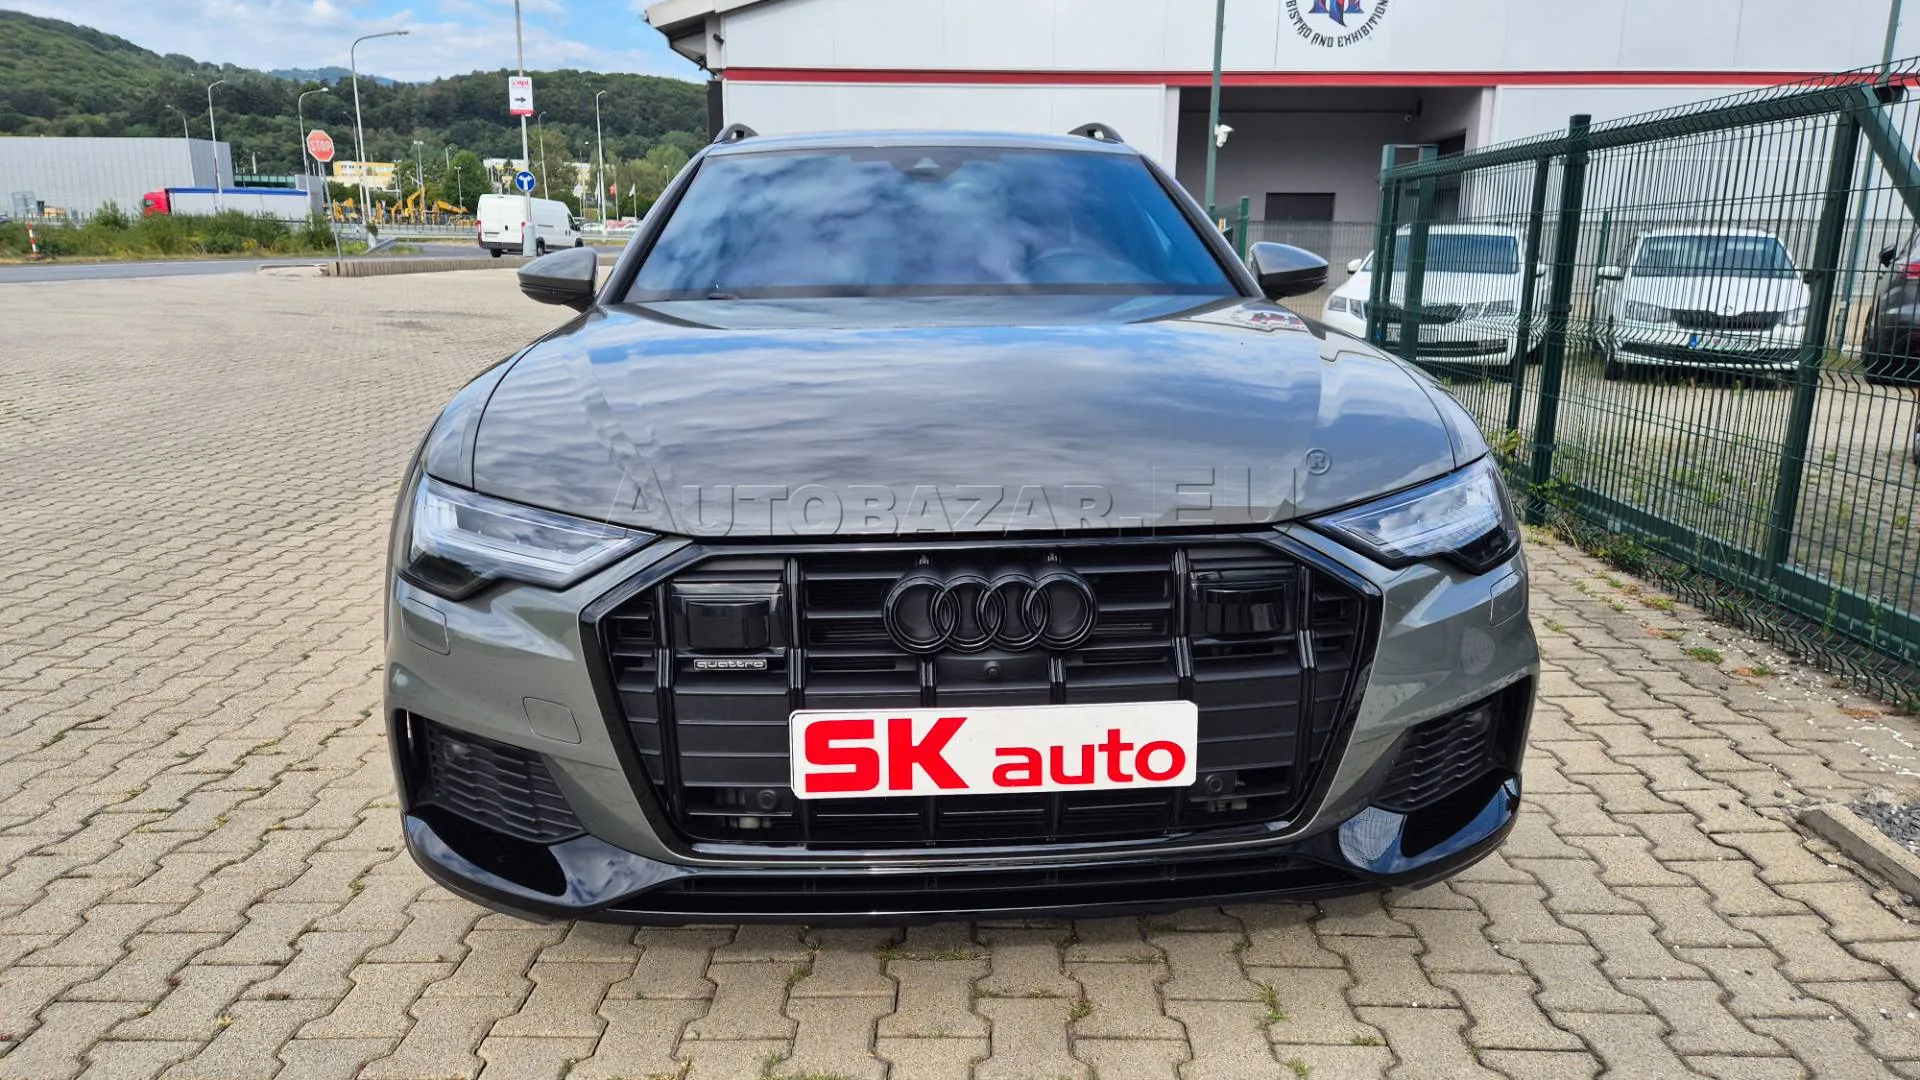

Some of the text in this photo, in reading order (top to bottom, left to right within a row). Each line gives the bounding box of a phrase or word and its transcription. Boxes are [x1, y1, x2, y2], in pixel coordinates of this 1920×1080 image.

[1286, 0, 1312, 38] BISTRO
[1311, 32, 1334, 48] AND
[310, 139, 331, 152] STOP
[696, 661, 763, 669] quattro
[804, 716, 1186, 793] SK auto
